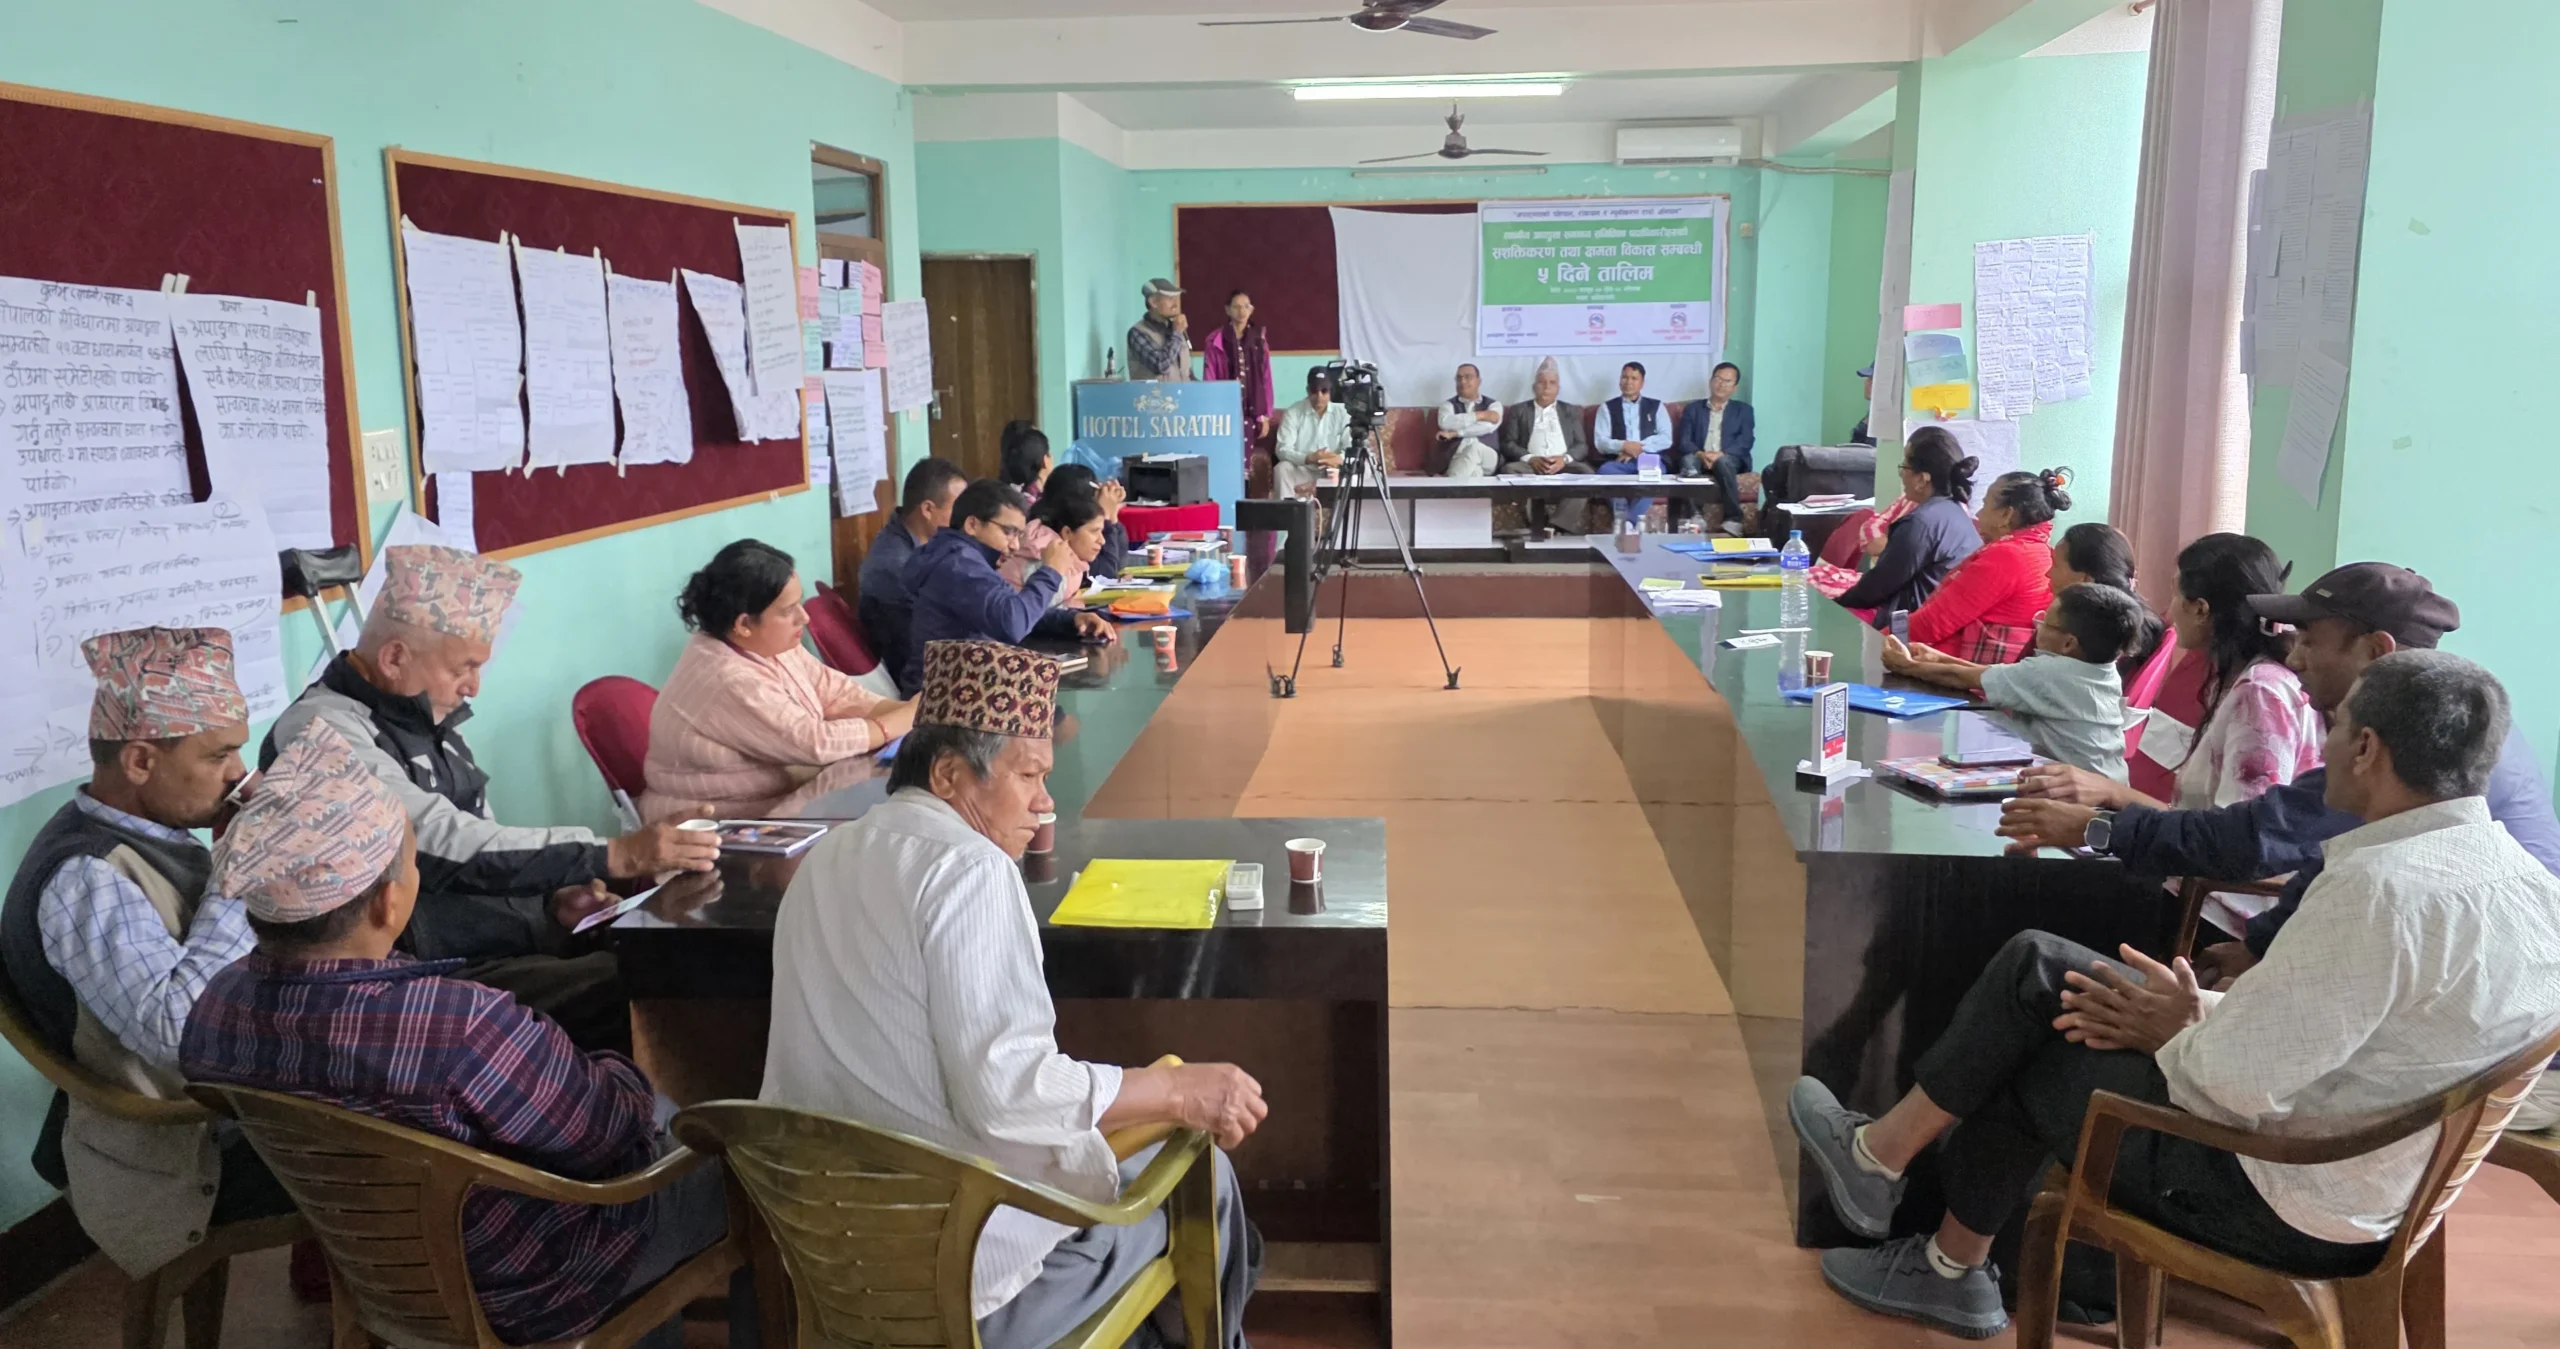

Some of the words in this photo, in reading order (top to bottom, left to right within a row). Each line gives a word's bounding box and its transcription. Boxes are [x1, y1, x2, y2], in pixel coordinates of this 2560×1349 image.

[1559, 246, 1581, 258] तथा
[1584, 245, 1617, 259] क्षमता
[1621, 241, 1656, 256] विकास
[1538, 267, 1549, 284] ५
[1557, 262, 1591, 283] दिने
[1598, 261, 1655, 282] तालिम
[1082, 415, 1146, 438] HOTEL
[1150, 414, 1232, 438] SARATHI
